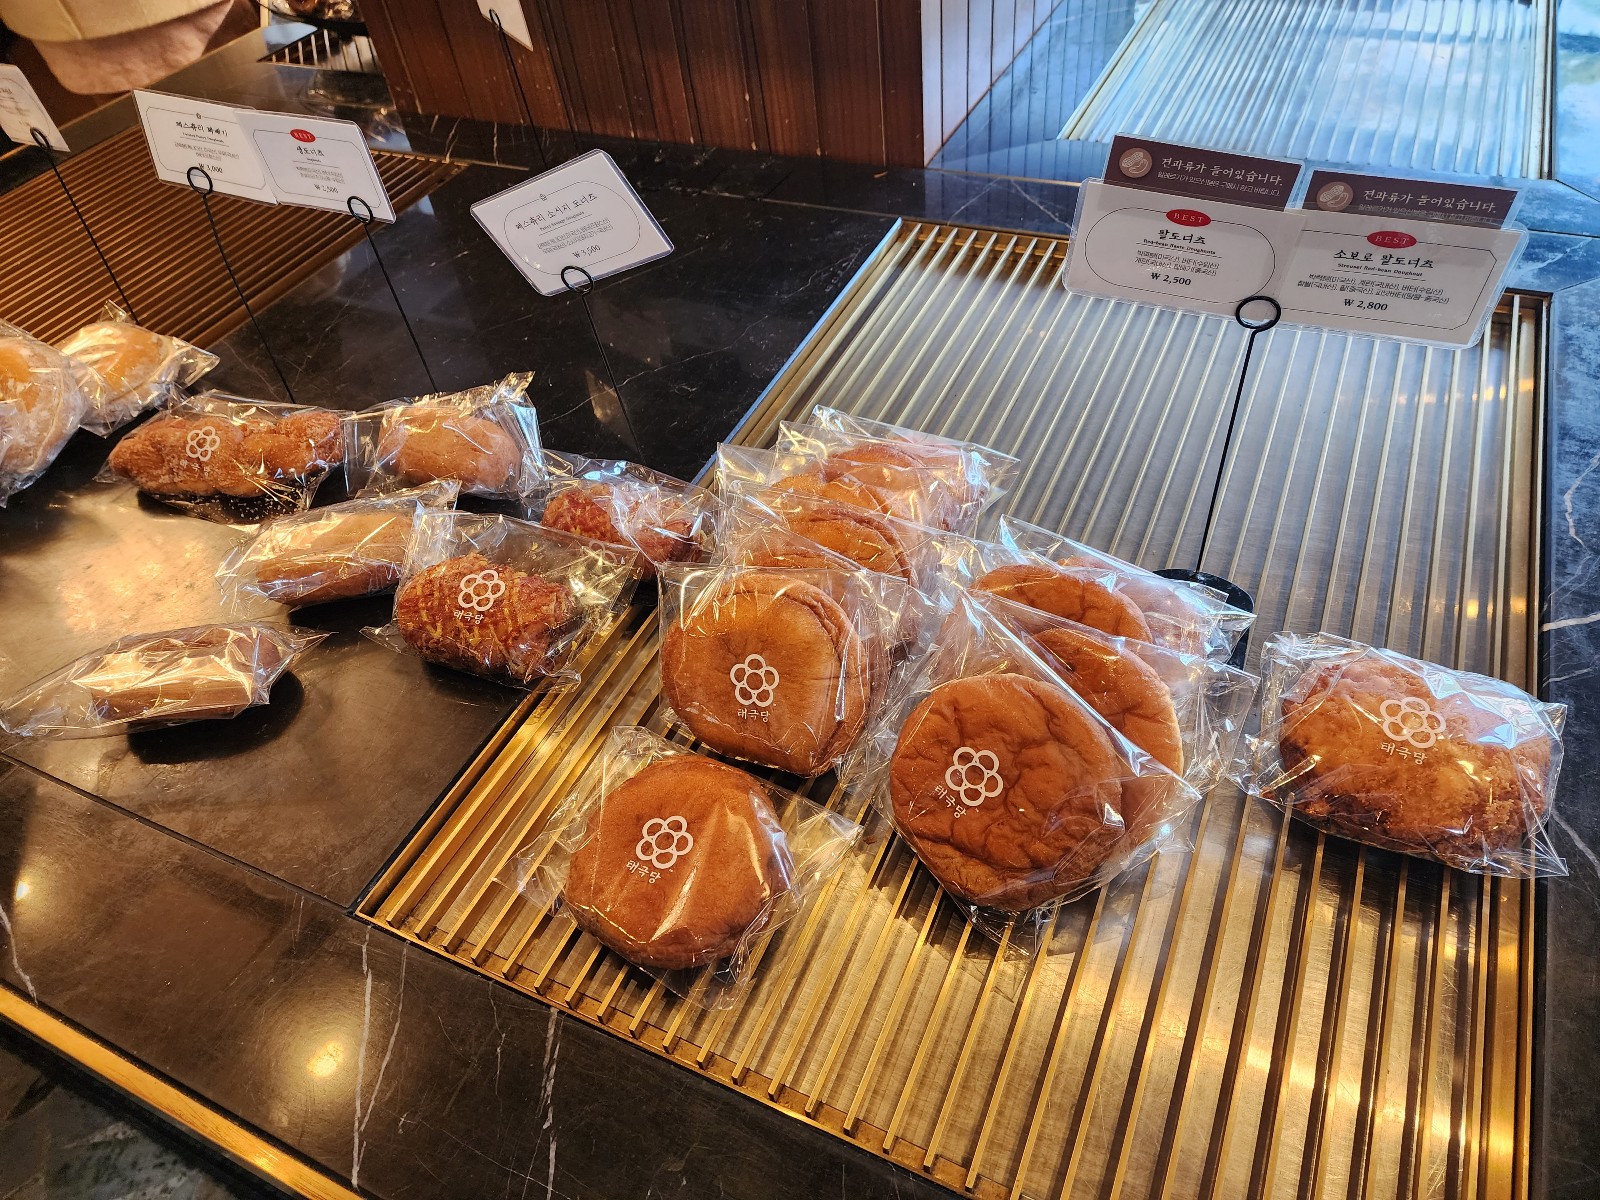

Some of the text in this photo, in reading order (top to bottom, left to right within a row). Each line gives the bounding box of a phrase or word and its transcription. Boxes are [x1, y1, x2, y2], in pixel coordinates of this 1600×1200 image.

[293, 131, 312, 140] BEST
[1161, 157, 1283, 187] 견과류가 들어있습니다.
[547, 202, 572, 219] 소시지
[572, 193, 598, 208] 도너츠
[1363, 189, 1497, 214] 견과류가 들어있습니다.
[1173, 213, 1204, 223] BEST
[1375, 235, 1411, 245] BEST
[581, 244, 601, 256] 3,500
[1333, 250, 1374, 262] 소보로
[1393, 269, 1423, 277] Doughnut
[1162, 275, 1192, 286] 2,500
[1356, 300, 1388, 311] 2,800
[454, 610, 484, 624] 태극당
[737, 708, 770, 723] 태극당
[1381, 742, 1427, 765] 태극당
[935, 785, 967, 818] 태극당
[626, 860, 661, 883] 태극당
